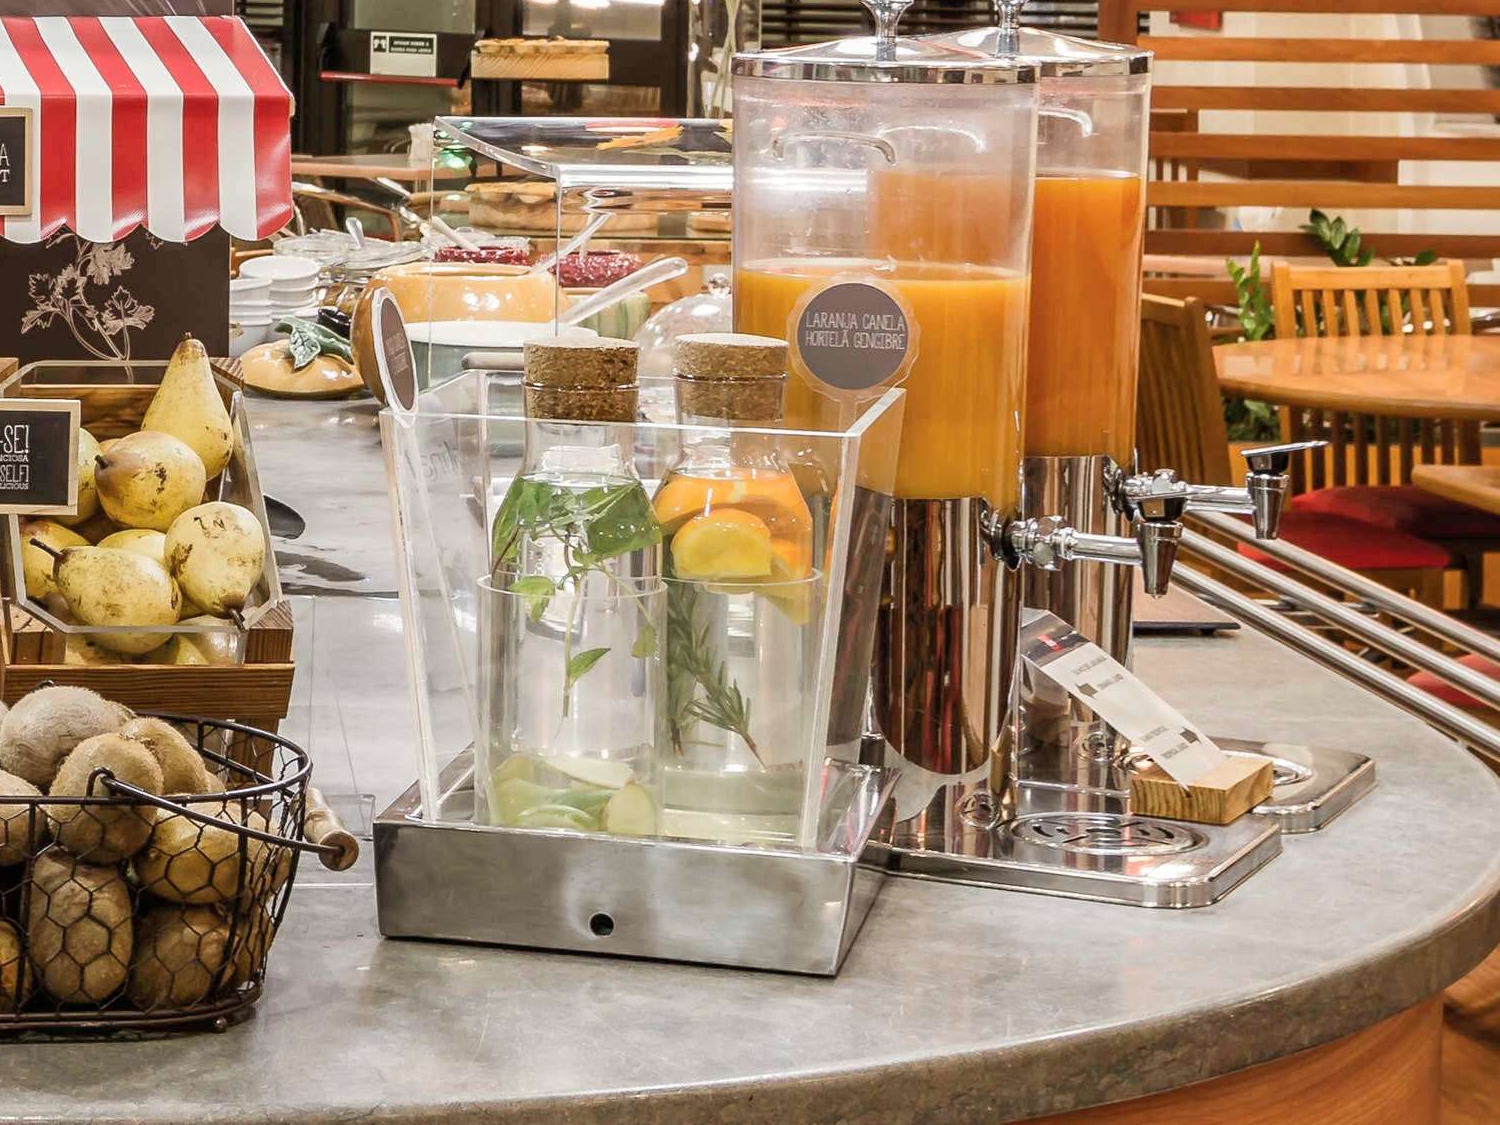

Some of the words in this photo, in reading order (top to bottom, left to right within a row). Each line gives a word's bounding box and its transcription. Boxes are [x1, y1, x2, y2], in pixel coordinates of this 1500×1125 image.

[805, 312, 858, 329] LARANJA
[862, 314, 905, 331] CANELA
[805, 330, 849, 348] HORTELÃ
[853, 332, 905, 350] GENGIBRE
